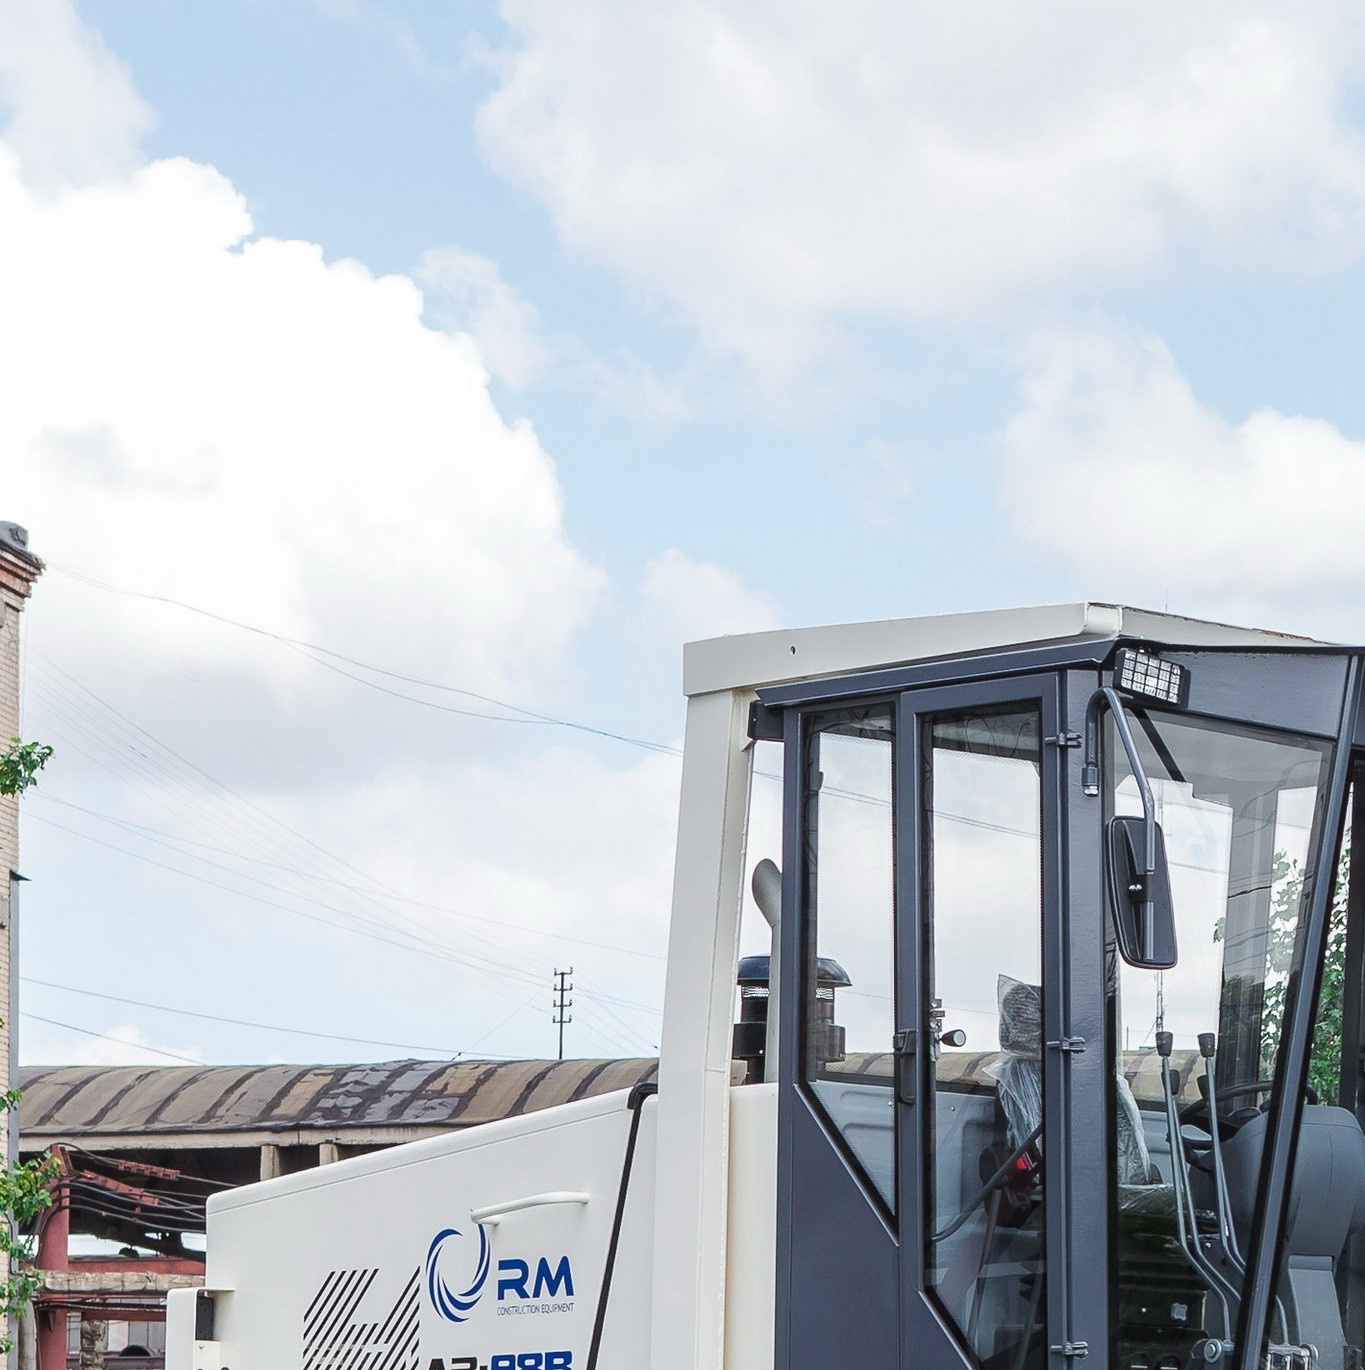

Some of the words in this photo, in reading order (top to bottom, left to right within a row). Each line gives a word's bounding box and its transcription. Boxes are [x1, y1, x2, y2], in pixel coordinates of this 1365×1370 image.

[498, 1255, 574, 1300] RM
[497, 1304, 540, 1316] CONSTRUCTION
[541, 1302, 575, 1314] EQUIPMENT
